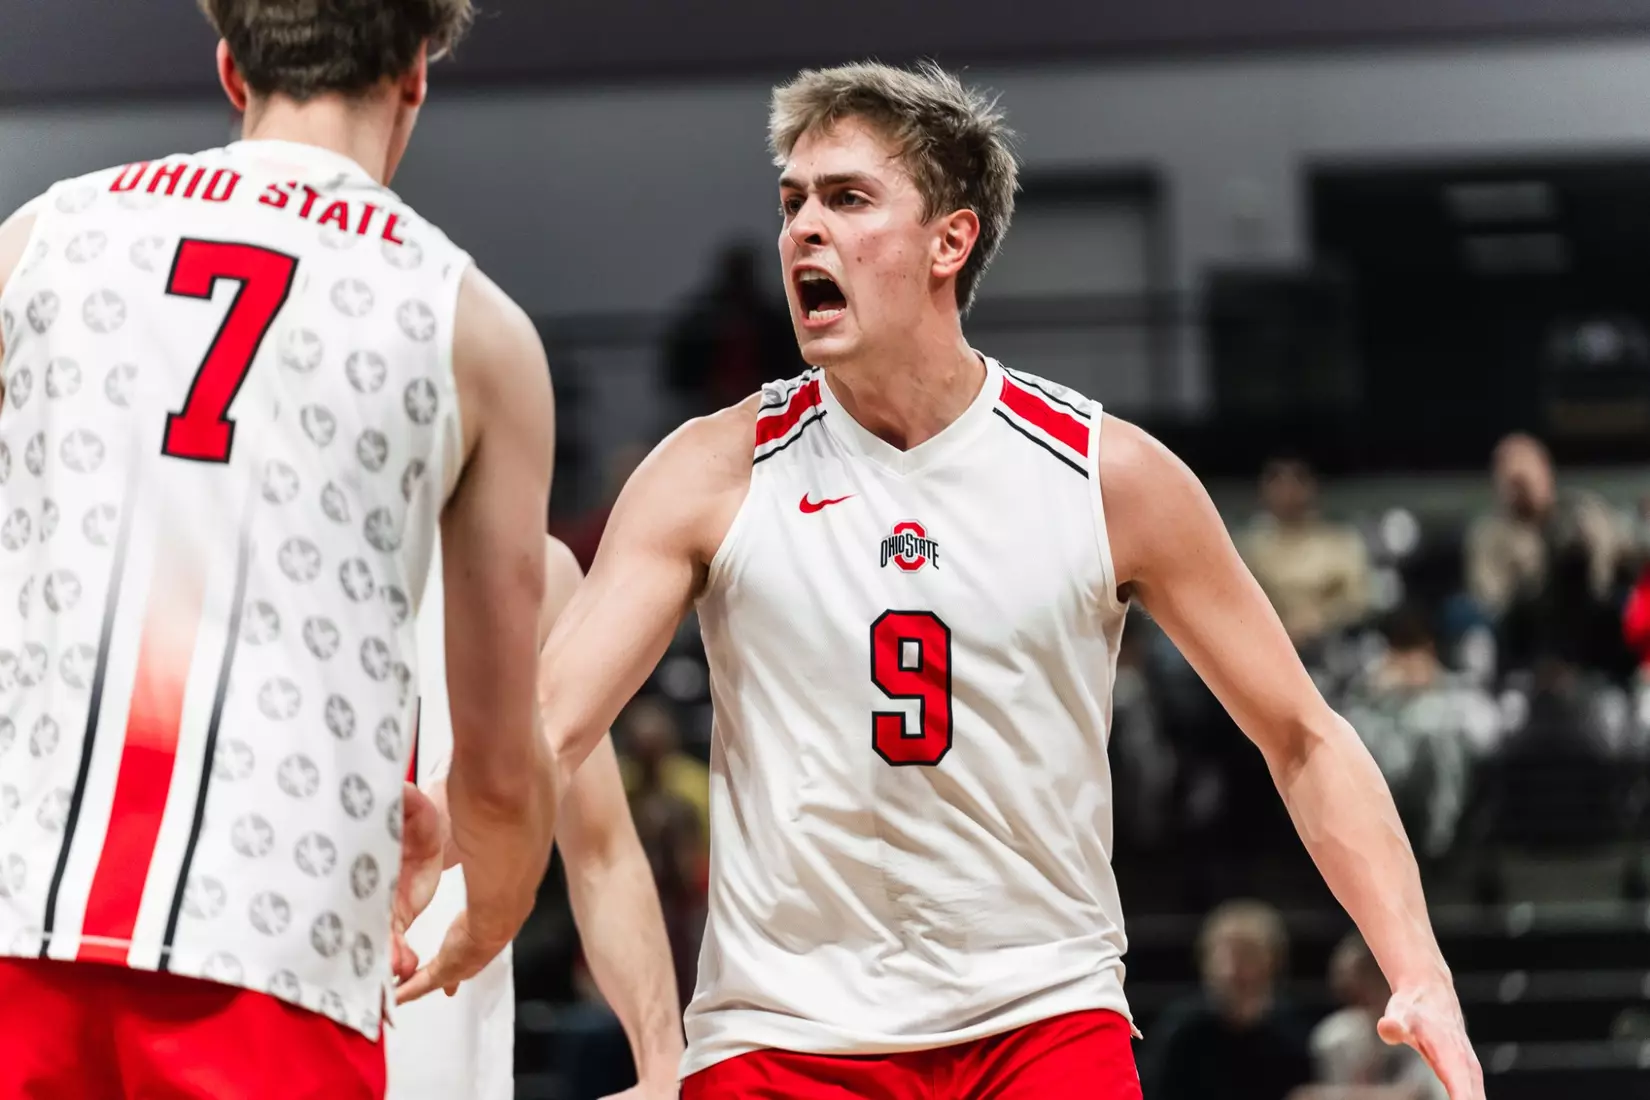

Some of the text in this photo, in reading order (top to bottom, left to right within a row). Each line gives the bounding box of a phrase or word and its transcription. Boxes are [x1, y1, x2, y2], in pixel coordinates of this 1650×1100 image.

[109, 161, 242, 202] OHIO
[161, 237, 300, 464] 7
[870, 609, 953, 766] 9
